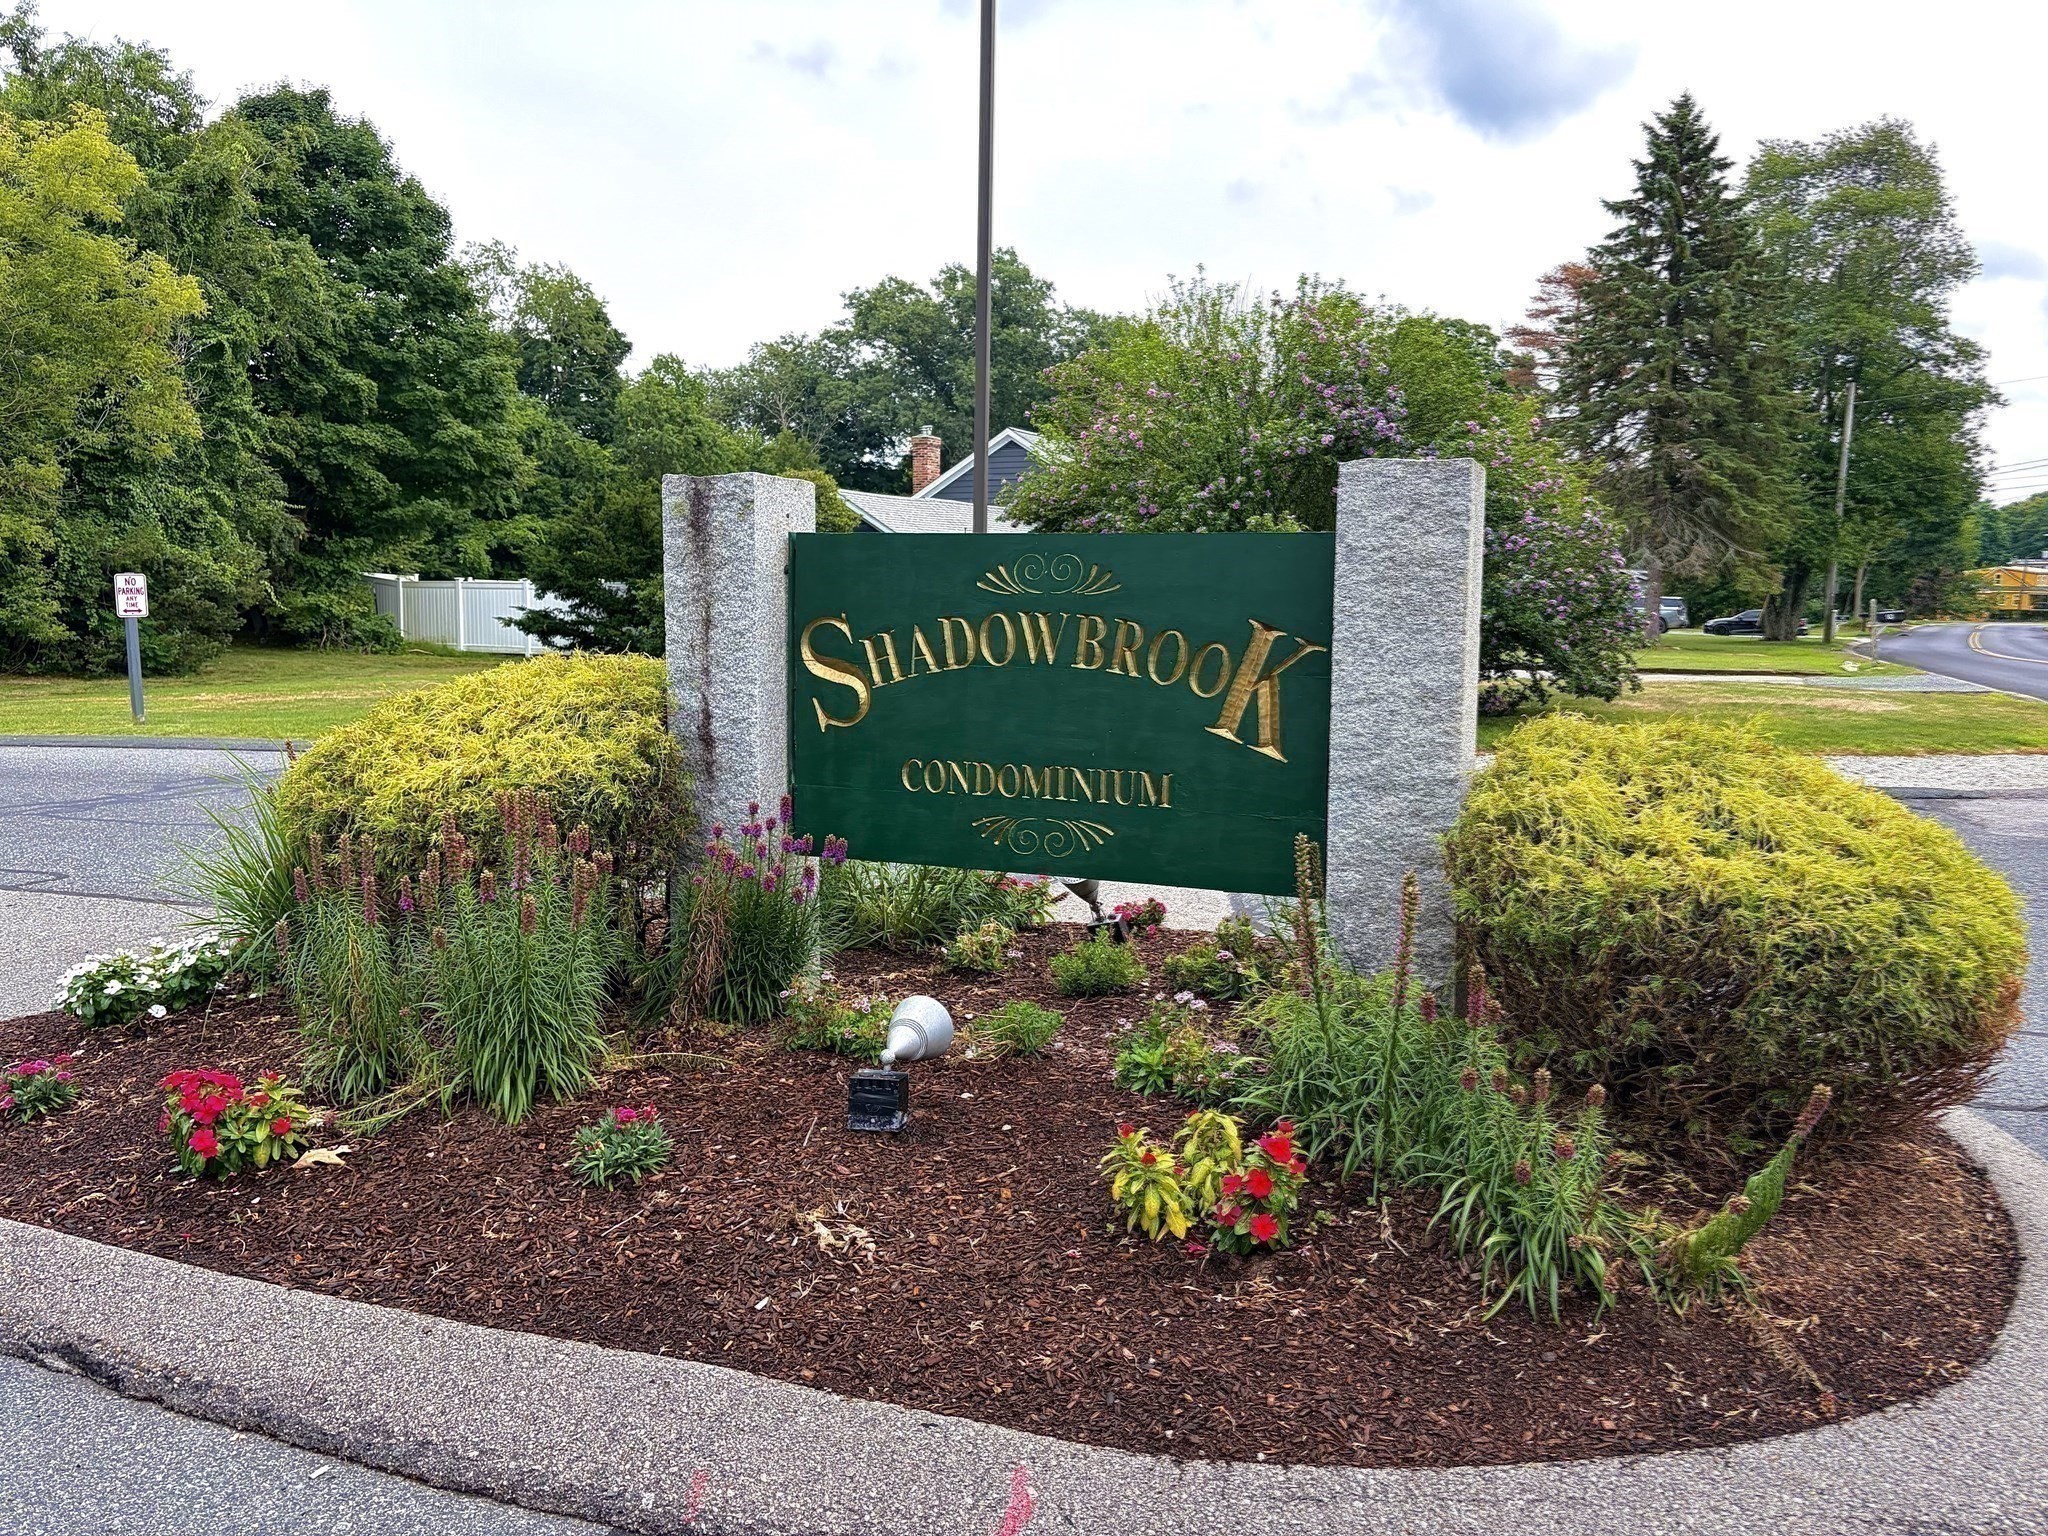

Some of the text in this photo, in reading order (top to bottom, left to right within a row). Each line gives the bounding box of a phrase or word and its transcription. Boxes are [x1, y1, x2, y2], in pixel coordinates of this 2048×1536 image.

[118, 587, 144, 595] PARKING
[125, 578, 136, 586] NO
[800, 611, 1328, 763] SHADOWBROOK
[900, 758, 1173, 808] CONDOMINIUM
